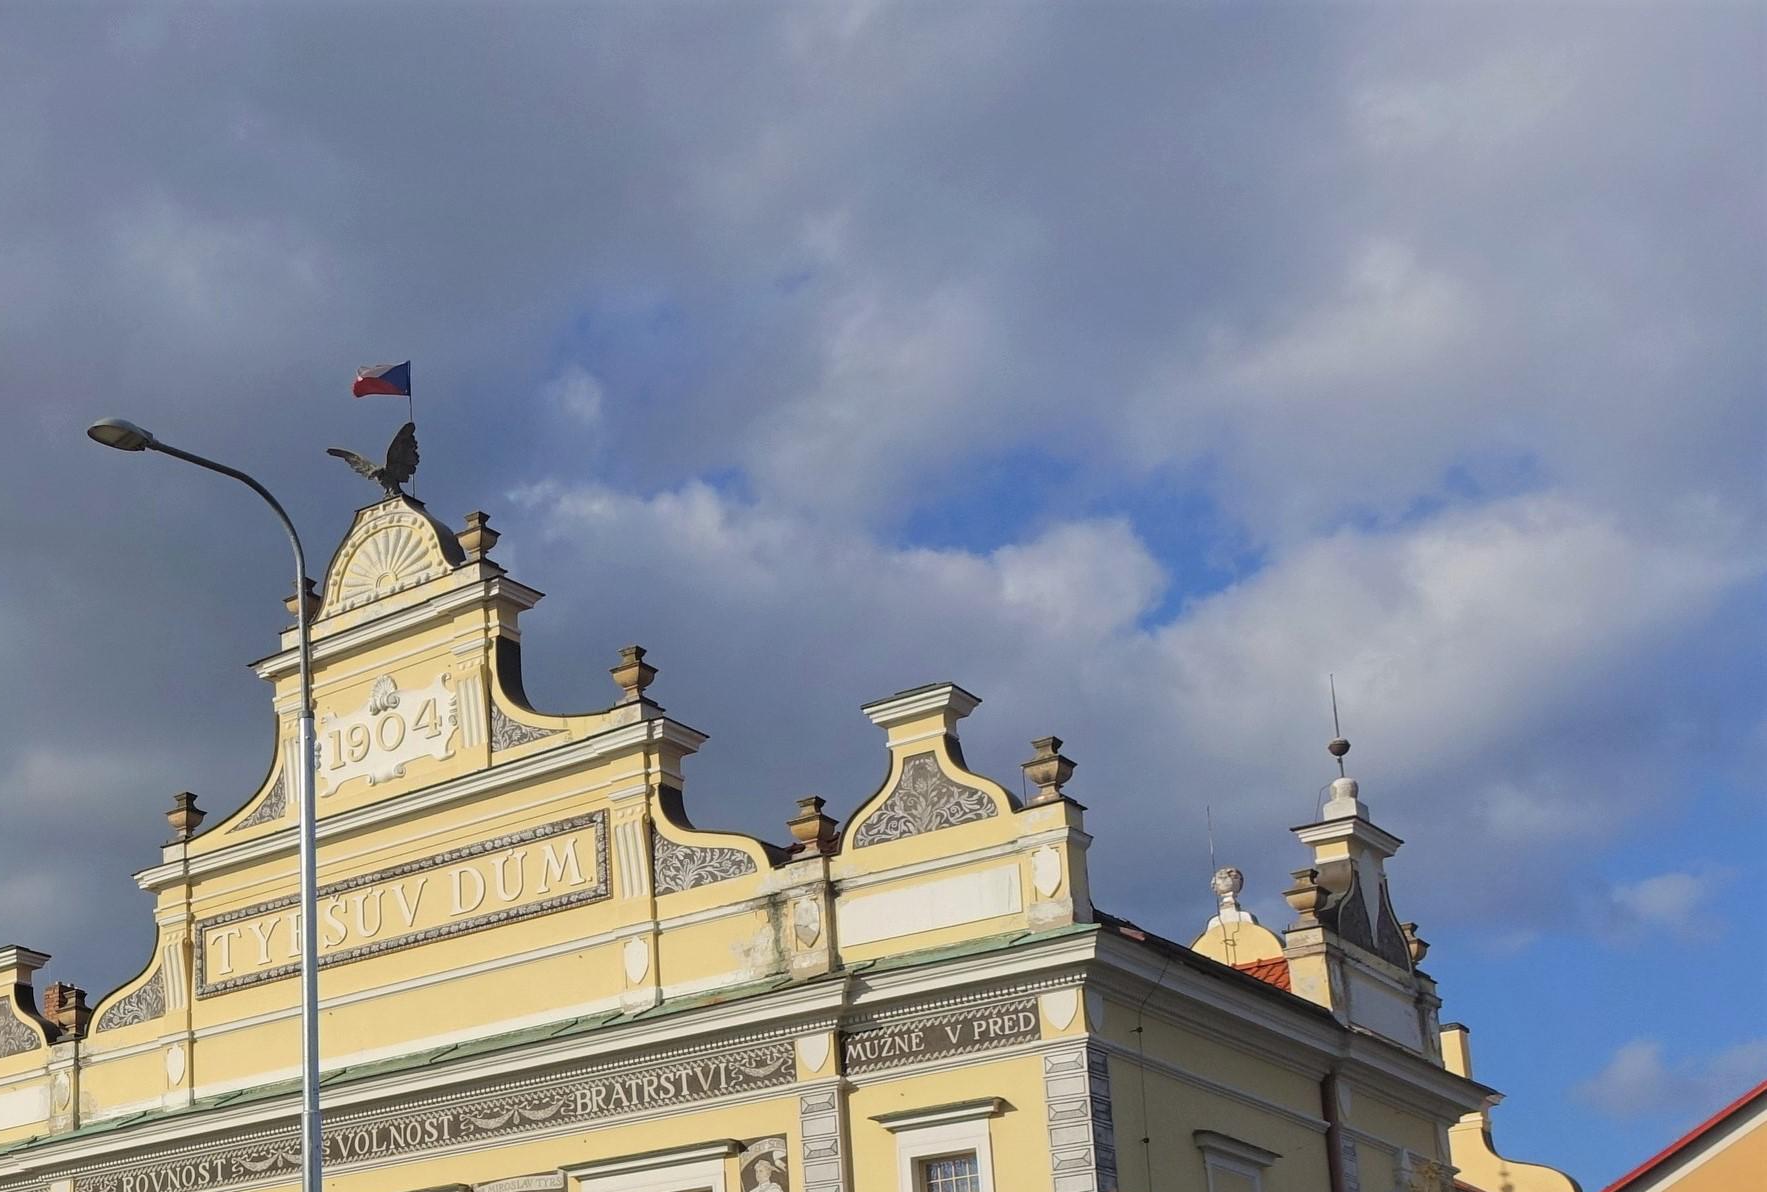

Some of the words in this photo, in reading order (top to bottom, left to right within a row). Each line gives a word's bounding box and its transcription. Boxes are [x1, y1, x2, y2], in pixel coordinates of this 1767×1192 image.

[327, 697, 443, 771] 1904
[945, 1024, 962, 1044] V
[335, 1115, 453, 1158] VOLNOST
